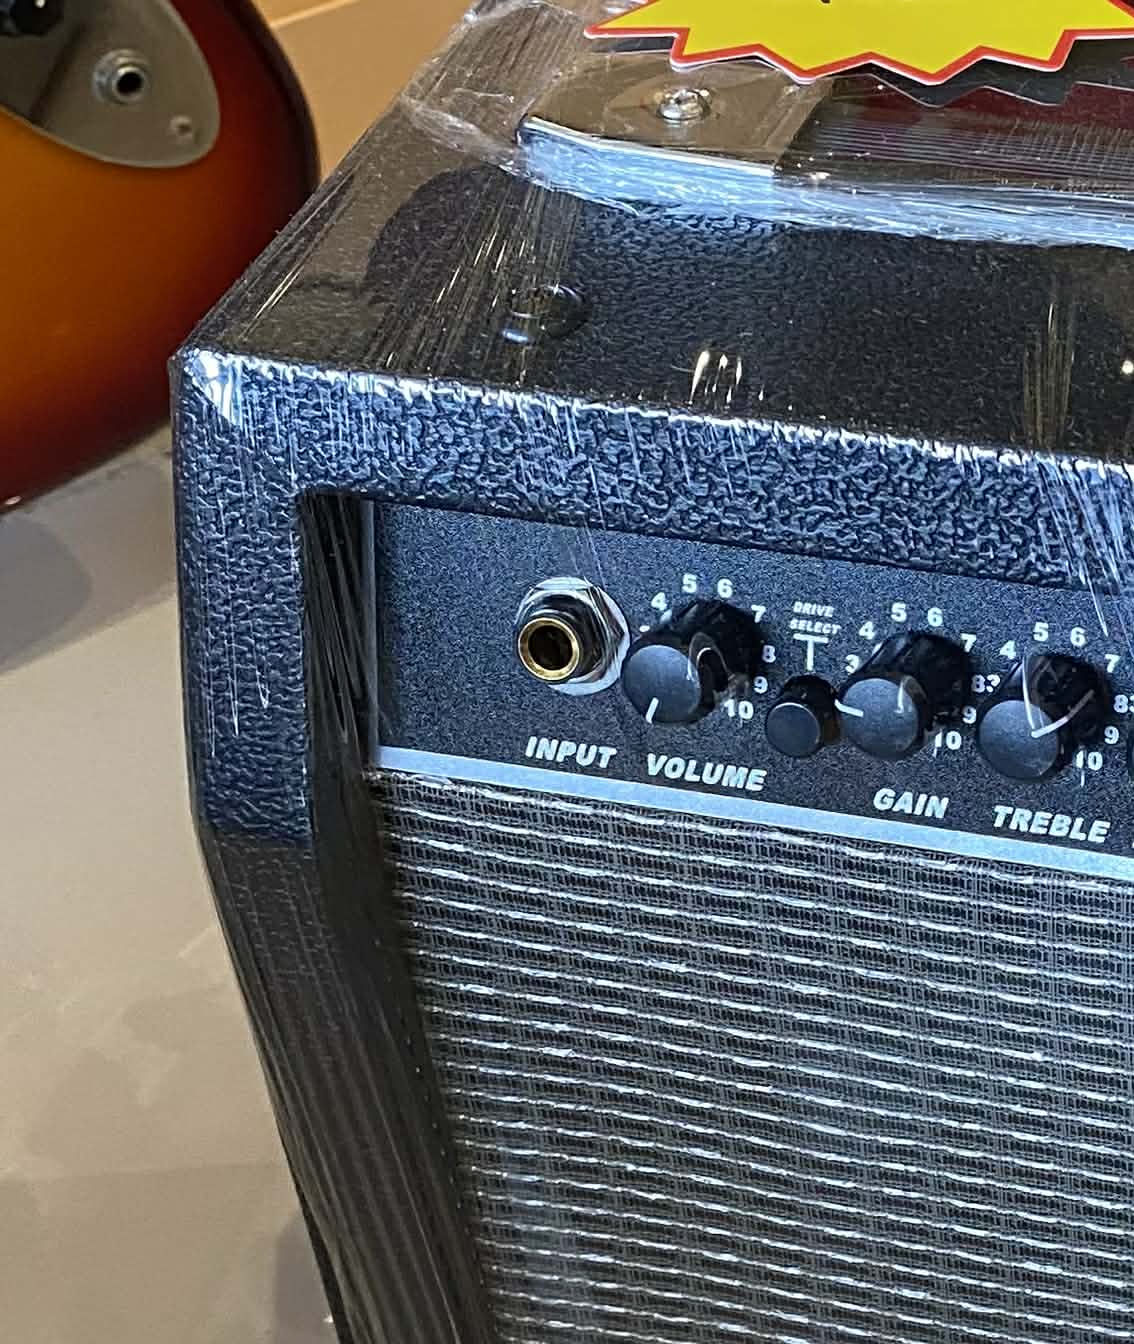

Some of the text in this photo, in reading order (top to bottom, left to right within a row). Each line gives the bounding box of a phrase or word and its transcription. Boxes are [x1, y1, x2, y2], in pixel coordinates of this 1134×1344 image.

[681, 573, 698, 593] 5
[717, 578, 733, 599] 6
[651, 592, 668, 611] 4
[793, 601, 835, 617] DRIVE
[751, 604, 767, 623] 7
[891, 602, 908, 622] 5
[927, 607, 944, 627] 6
[789, 618, 842, 635] SELECT
[858, 621, 875, 640] 4
[1033, 622, 1049, 642] 5
[960, 633, 977, 652] 7
[1070, 627, 1087, 647] 6
[762, 645, 776, 663] 8
[1000, 640, 1017, 659] 4
[845, 654, 860, 674] 3
[1104, 654, 1121, 673] 7
[753, 676, 768, 694] 9
[971, 674, 986, 693] 8
[723, 699, 754, 720] 10
[1114, 694, 1129, 713] 8
[962, 706, 977, 724] 9
[934, 730, 962, 750] 10
[1104, 726, 1120, 744] 9
[525, 736, 617, 769] INPUT
[1075, 750, 1103, 770] 10
[646, 753, 767, 792] VOLUME
[873, 788, 949, 819] GAIN
[992, 805, 1111, 844] TREBLE
